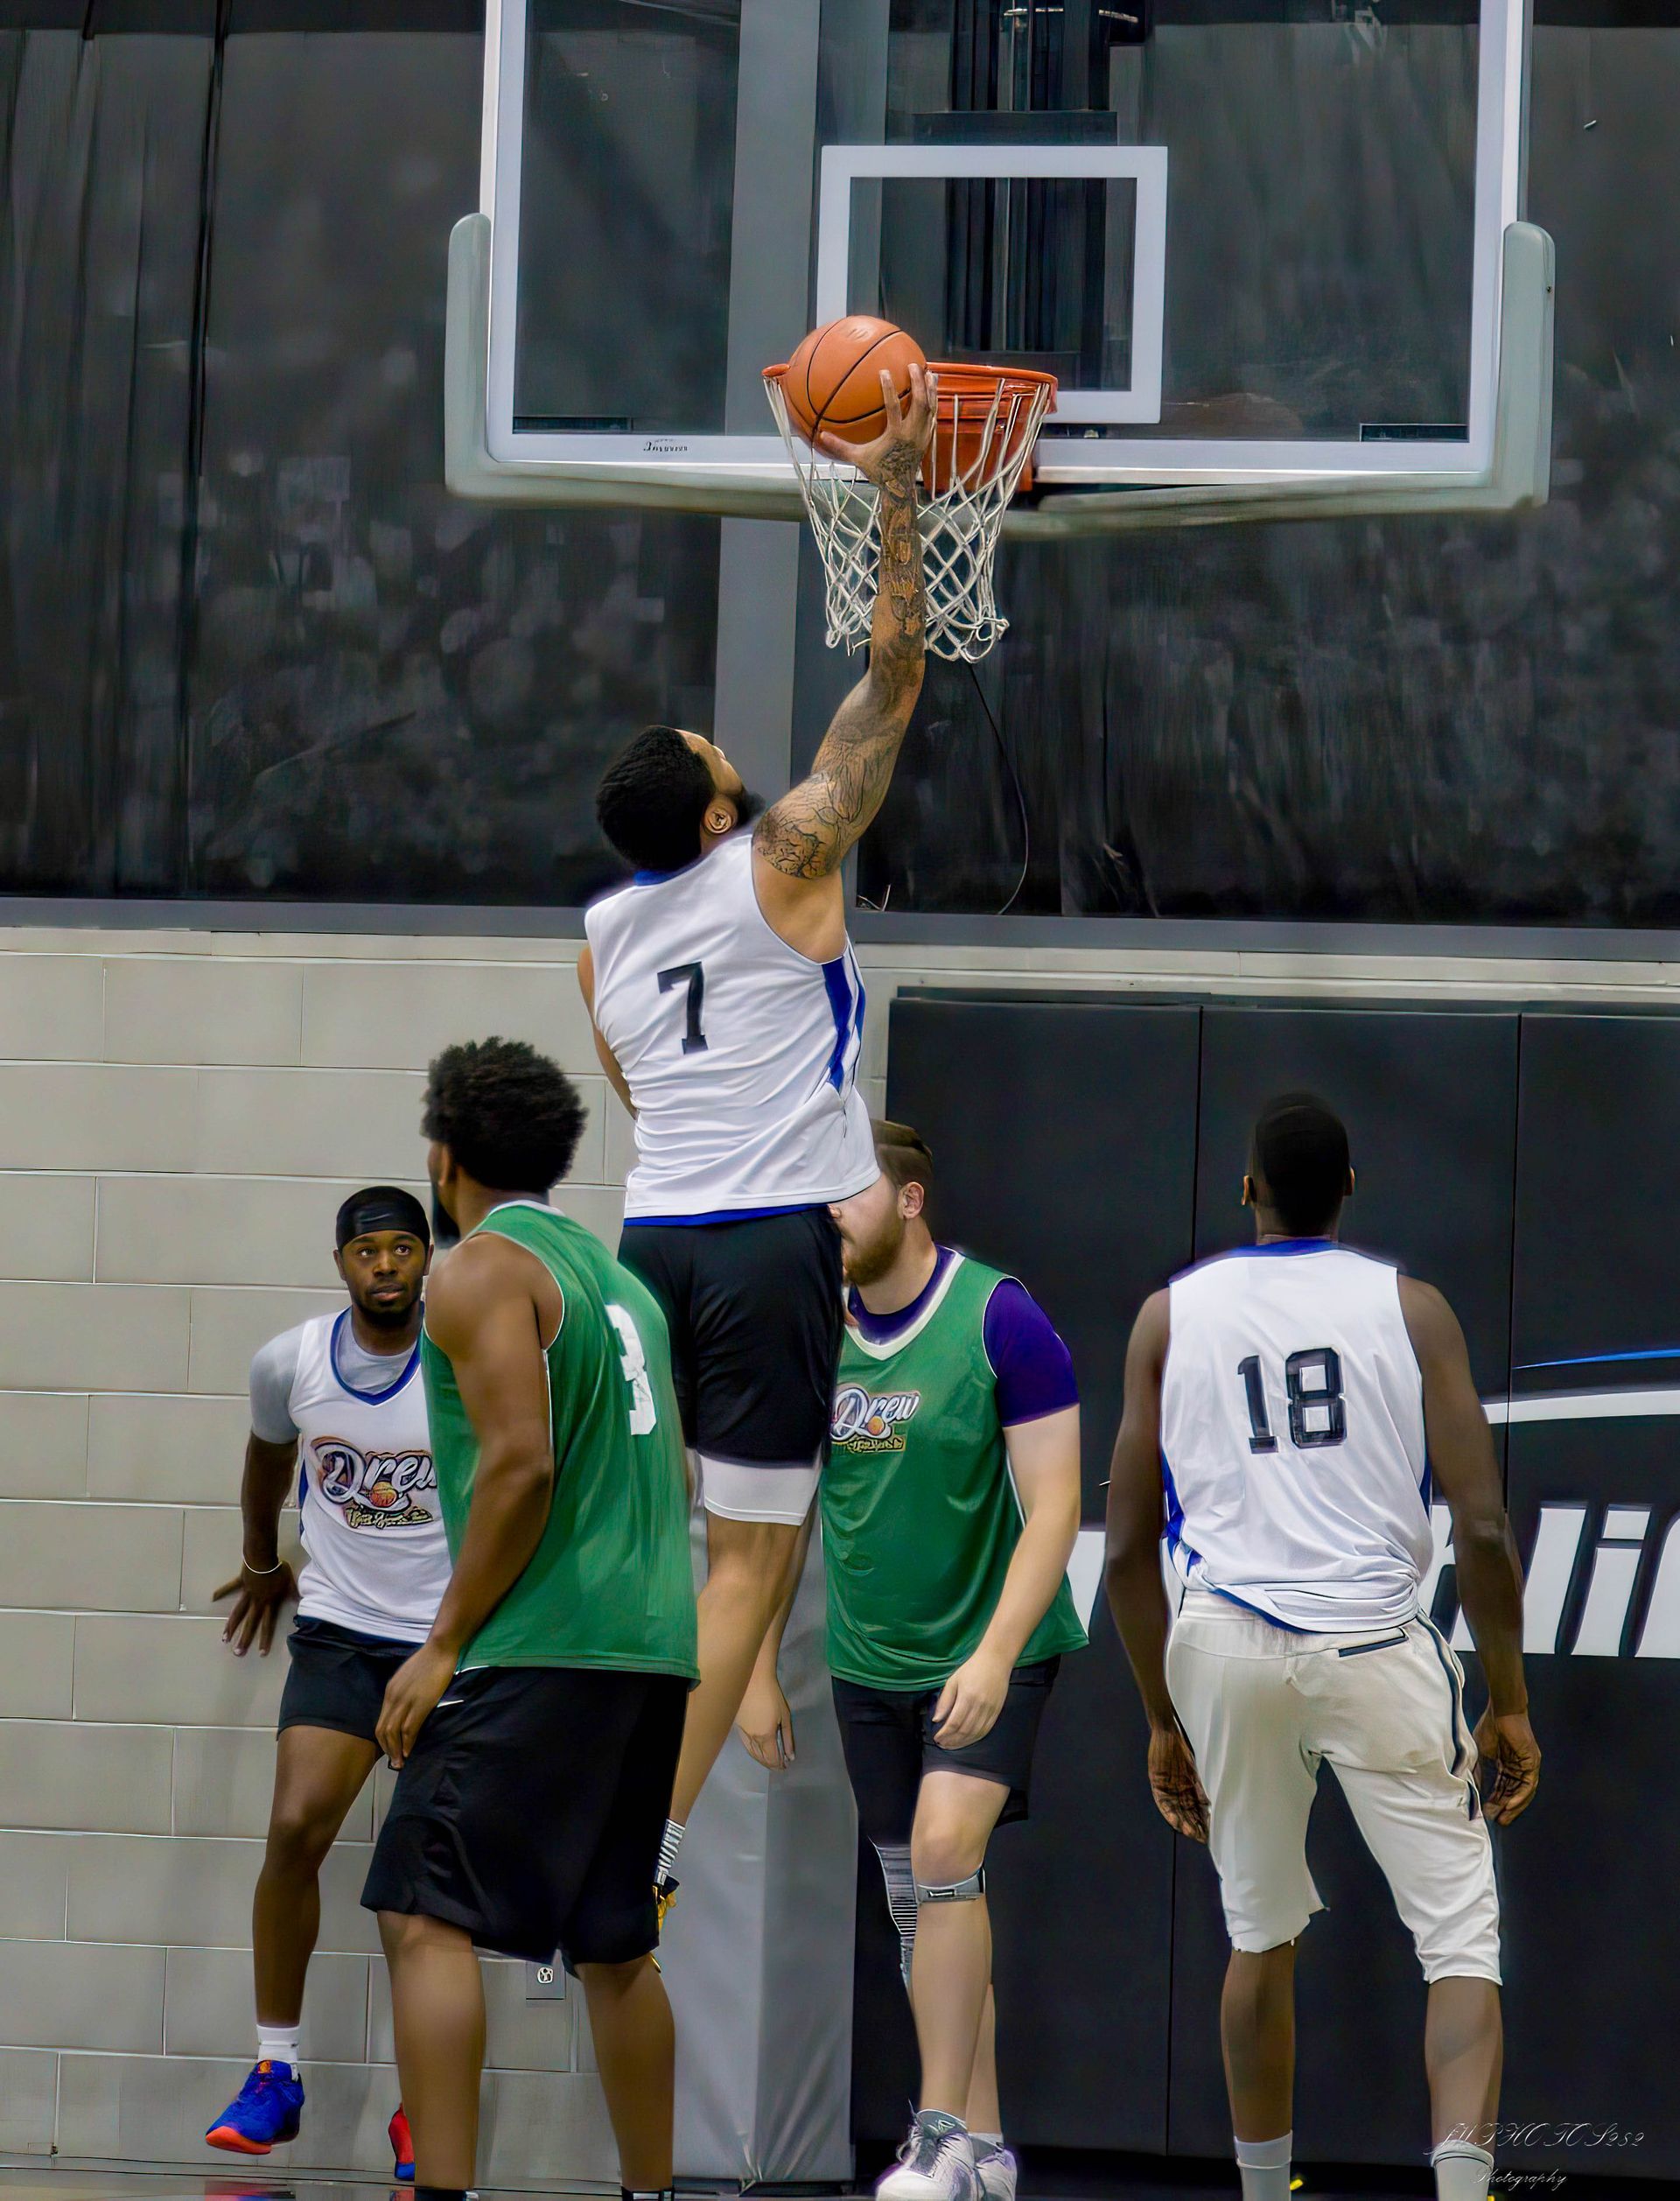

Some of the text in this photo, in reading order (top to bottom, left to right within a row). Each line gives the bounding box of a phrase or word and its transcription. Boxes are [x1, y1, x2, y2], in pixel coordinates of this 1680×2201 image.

[656, 961, 709, 1055] 7
[830, 1386, 920, 1442] Drew
[1237, 1347, 1348, 1454] 18
